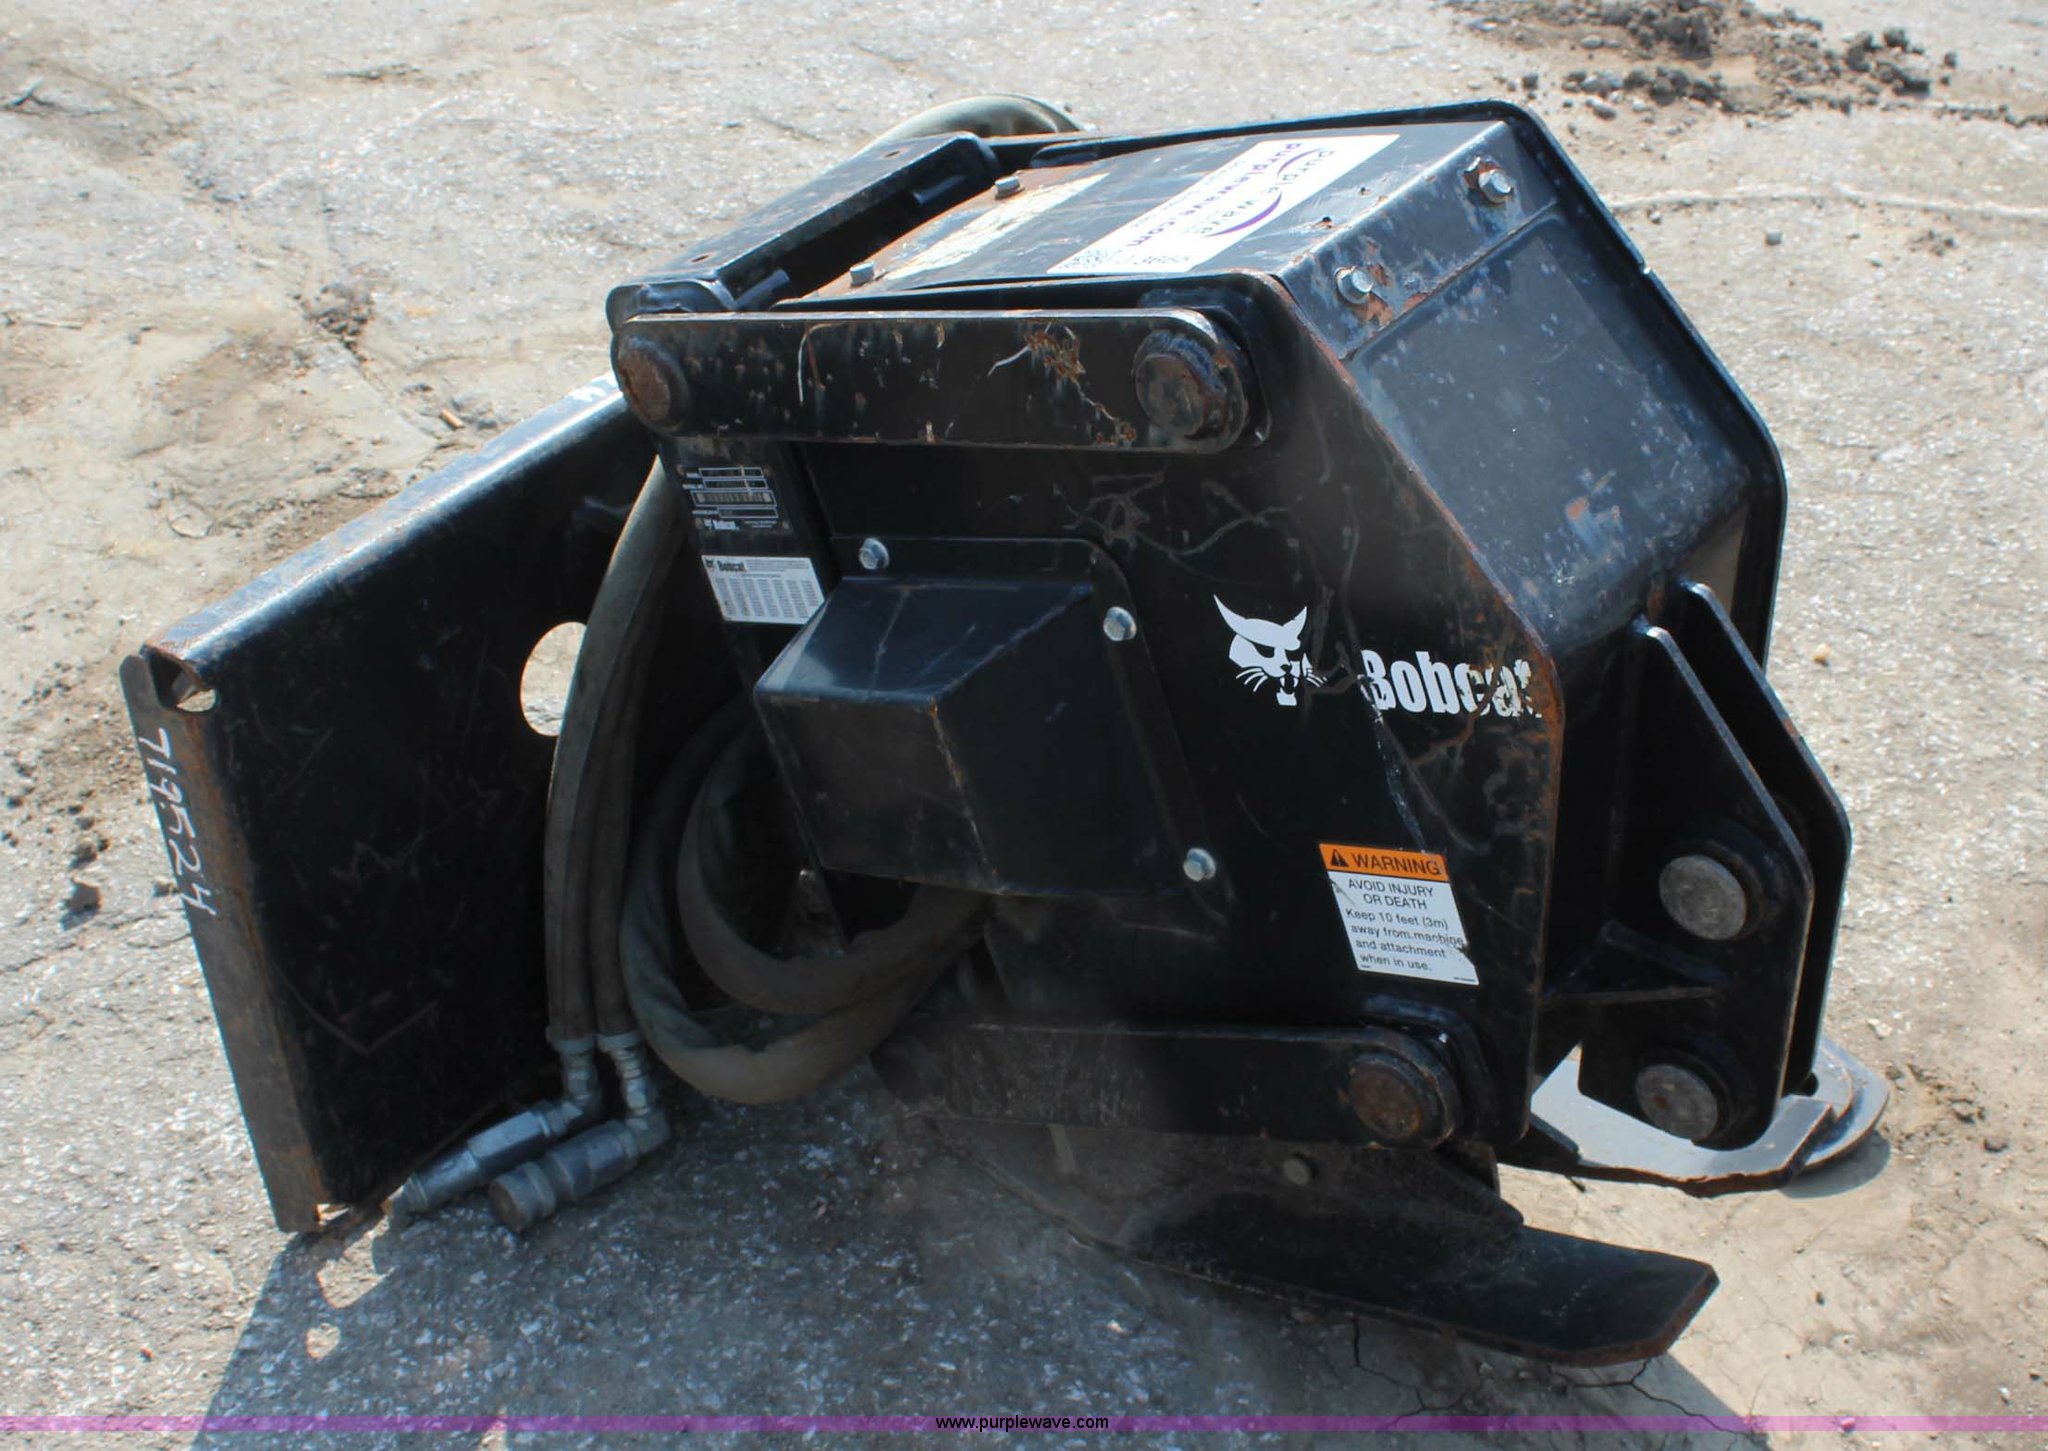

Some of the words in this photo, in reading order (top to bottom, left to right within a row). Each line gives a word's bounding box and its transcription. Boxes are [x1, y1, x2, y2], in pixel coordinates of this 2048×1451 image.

[138, 727, 217, 916] 719524
[1351, 853, 1442, 876] WARNING
[1349, 878, 1385, 893] AVOID
[1388, 882, 1434, 897] INJURY
[1363, 893, 1382, 905] OR
[1384, 896, 1428, 910] DEATH
[1346, 907, 1376, 922] Keep
[1379, 911, 1393, 922] 10
[1395, 912, 1419, 926] feet
[1422, 916, 1449, 931] (3m)
[1351, 924, 1381, 937] away
[1413, 931, 1465, 947] machine
[1355, 938, 1377, 950] and
[1380, 941, 1447, 959] attachment
[1360, 953, 1391, 966] when
[1393, 956, 1404, 968] in
[1406, 960, 1433, 972] use.
